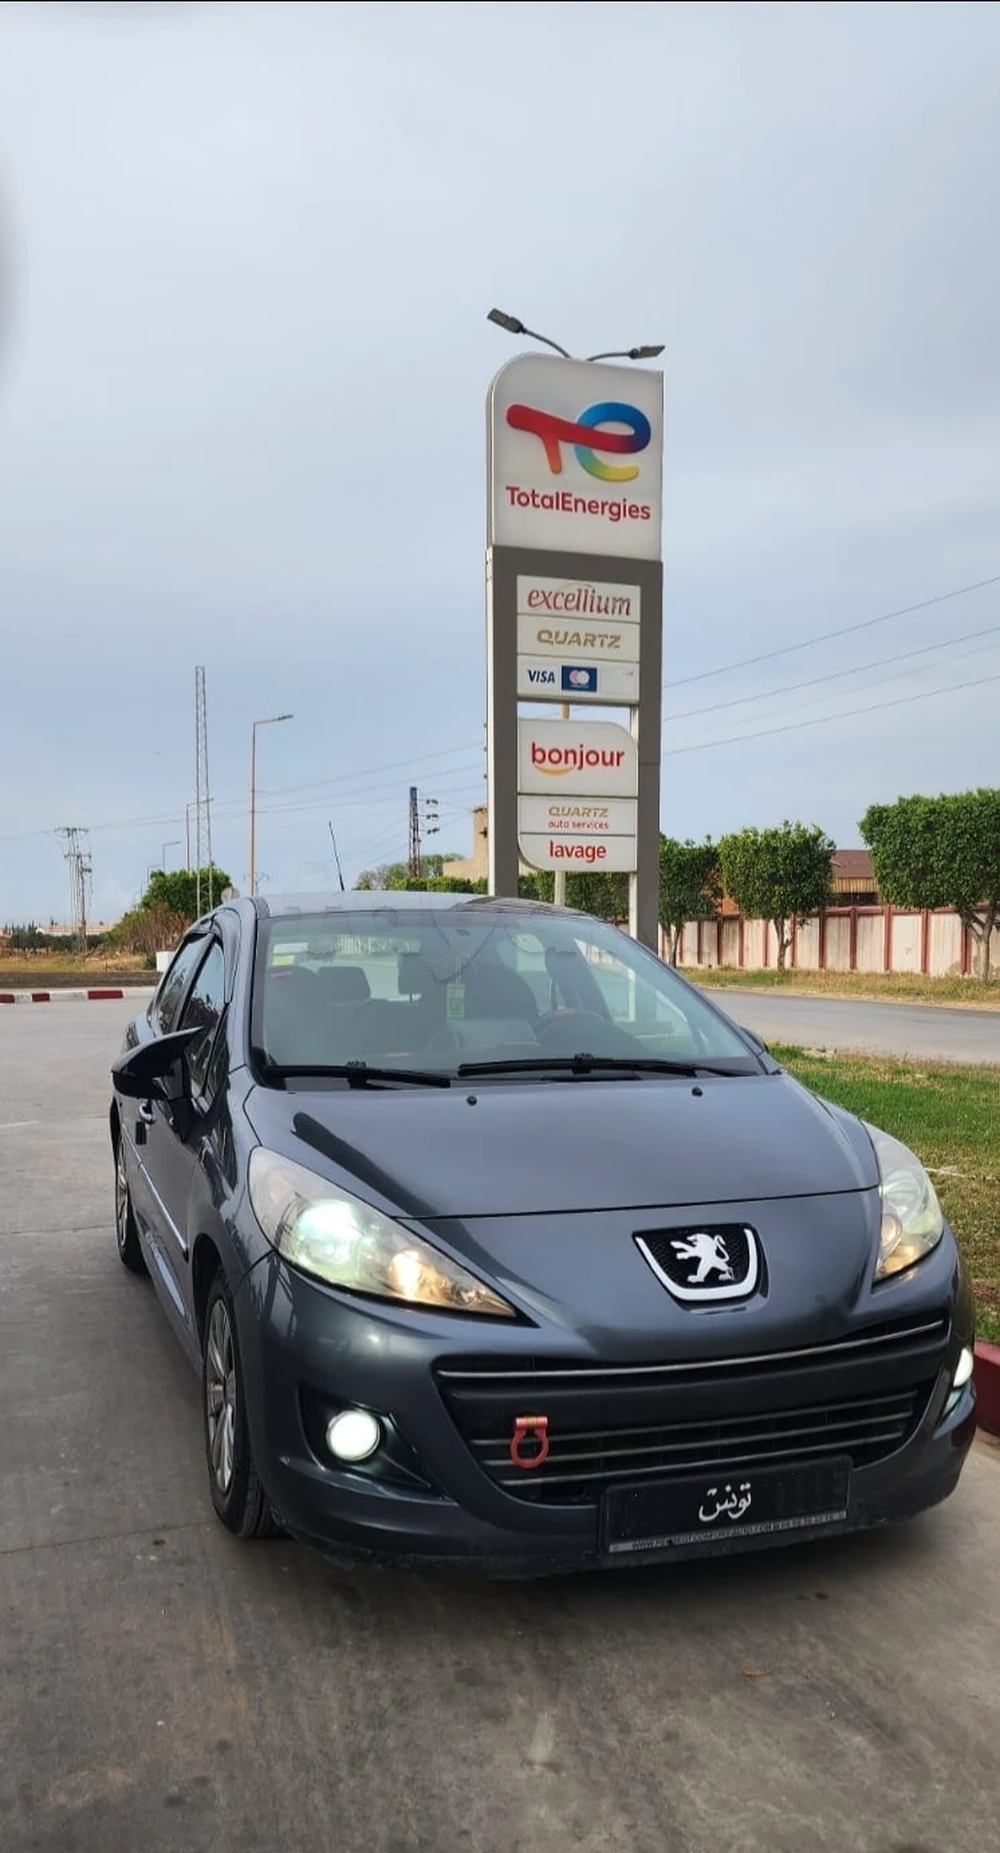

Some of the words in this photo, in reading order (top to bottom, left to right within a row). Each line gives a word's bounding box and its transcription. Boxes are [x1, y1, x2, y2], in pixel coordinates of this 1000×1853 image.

[505, 486, 651, 522] TotalEnergies
[527, 588, 631, 616] excellium
[537, 629, 621, 649] QUARTZ
[527, 669, 555, 684] VISA
[531, 742, 625, 770] bonjour
[548, 806, 609, 818] QUARTZ
[548, 819, 569, 829] auto
[572, 820, 609, 830] services
[550, 840, 606, 863] lavage
[698, 1482, 752, 1522] تونس
